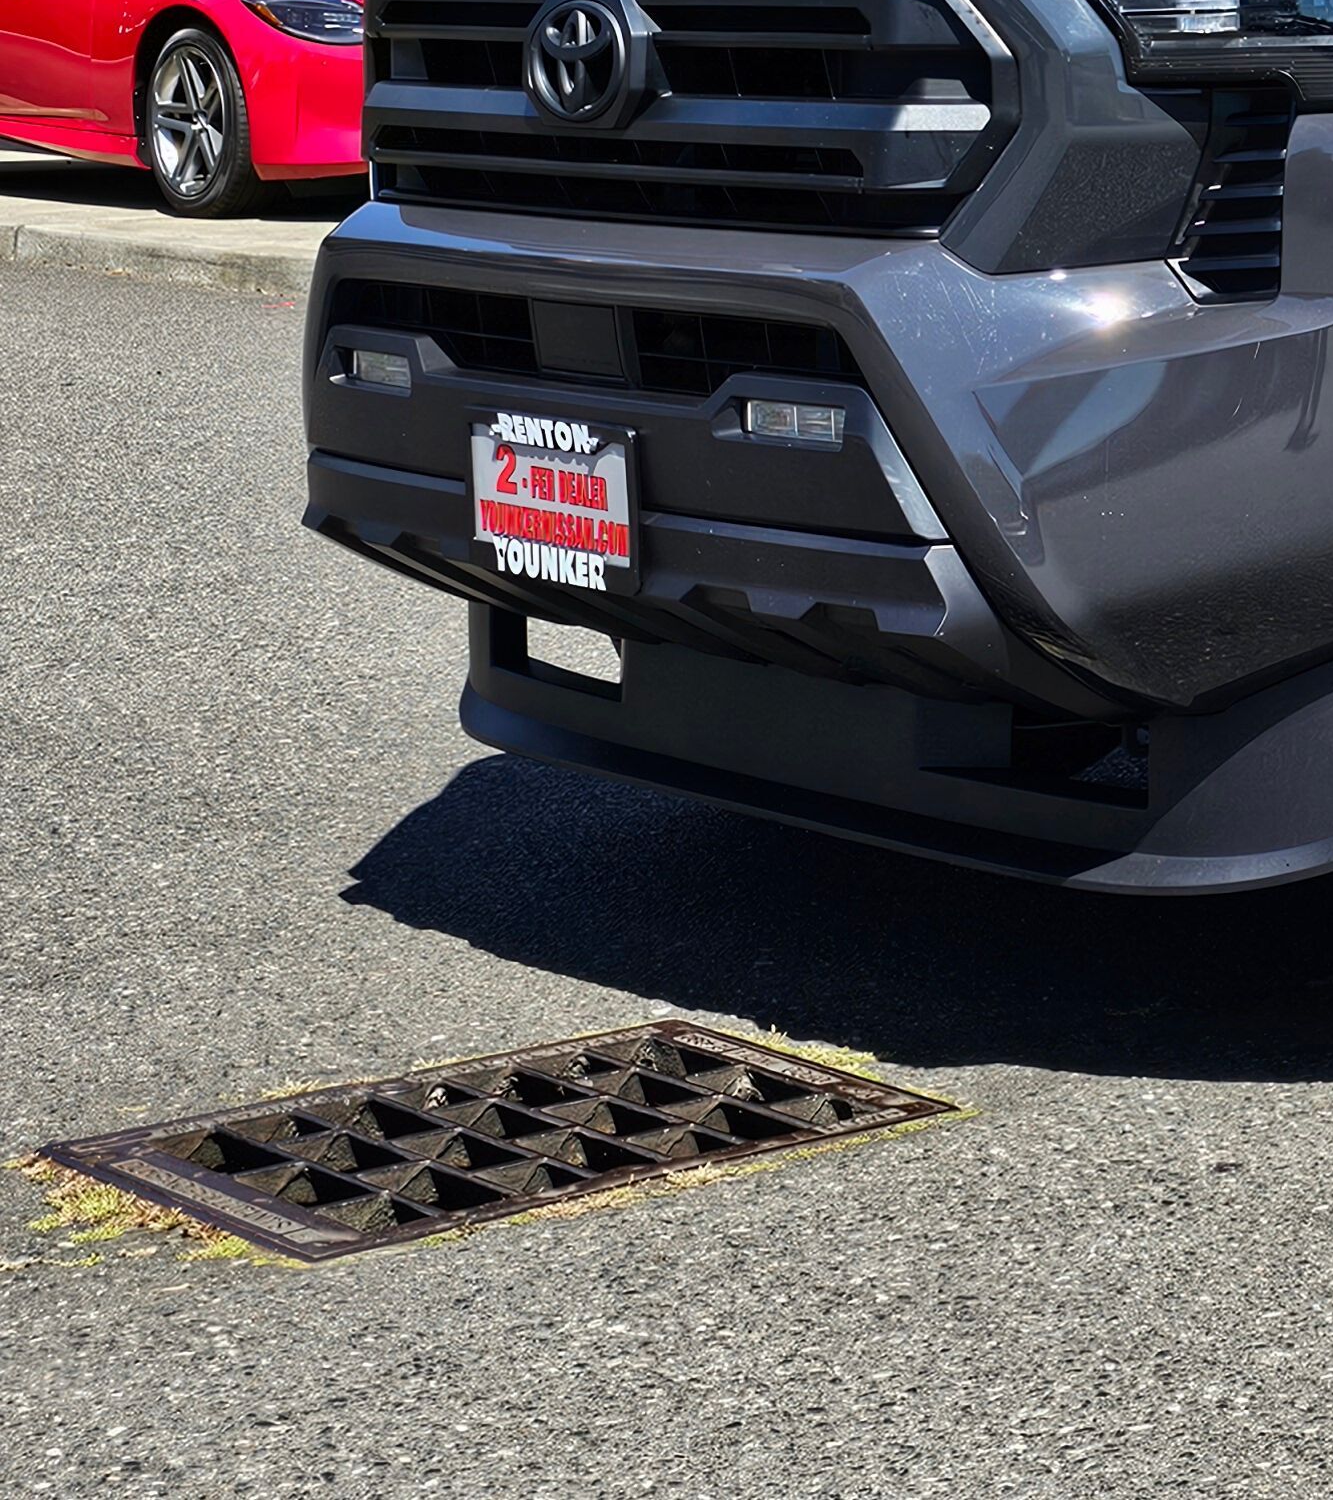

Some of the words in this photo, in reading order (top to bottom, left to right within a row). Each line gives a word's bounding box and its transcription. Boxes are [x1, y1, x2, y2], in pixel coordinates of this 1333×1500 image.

[497, 413, 591, 454] RENTON
[558, 470, 609, 512] DEALER
[493, 535, 607, 591] YOUNKER
